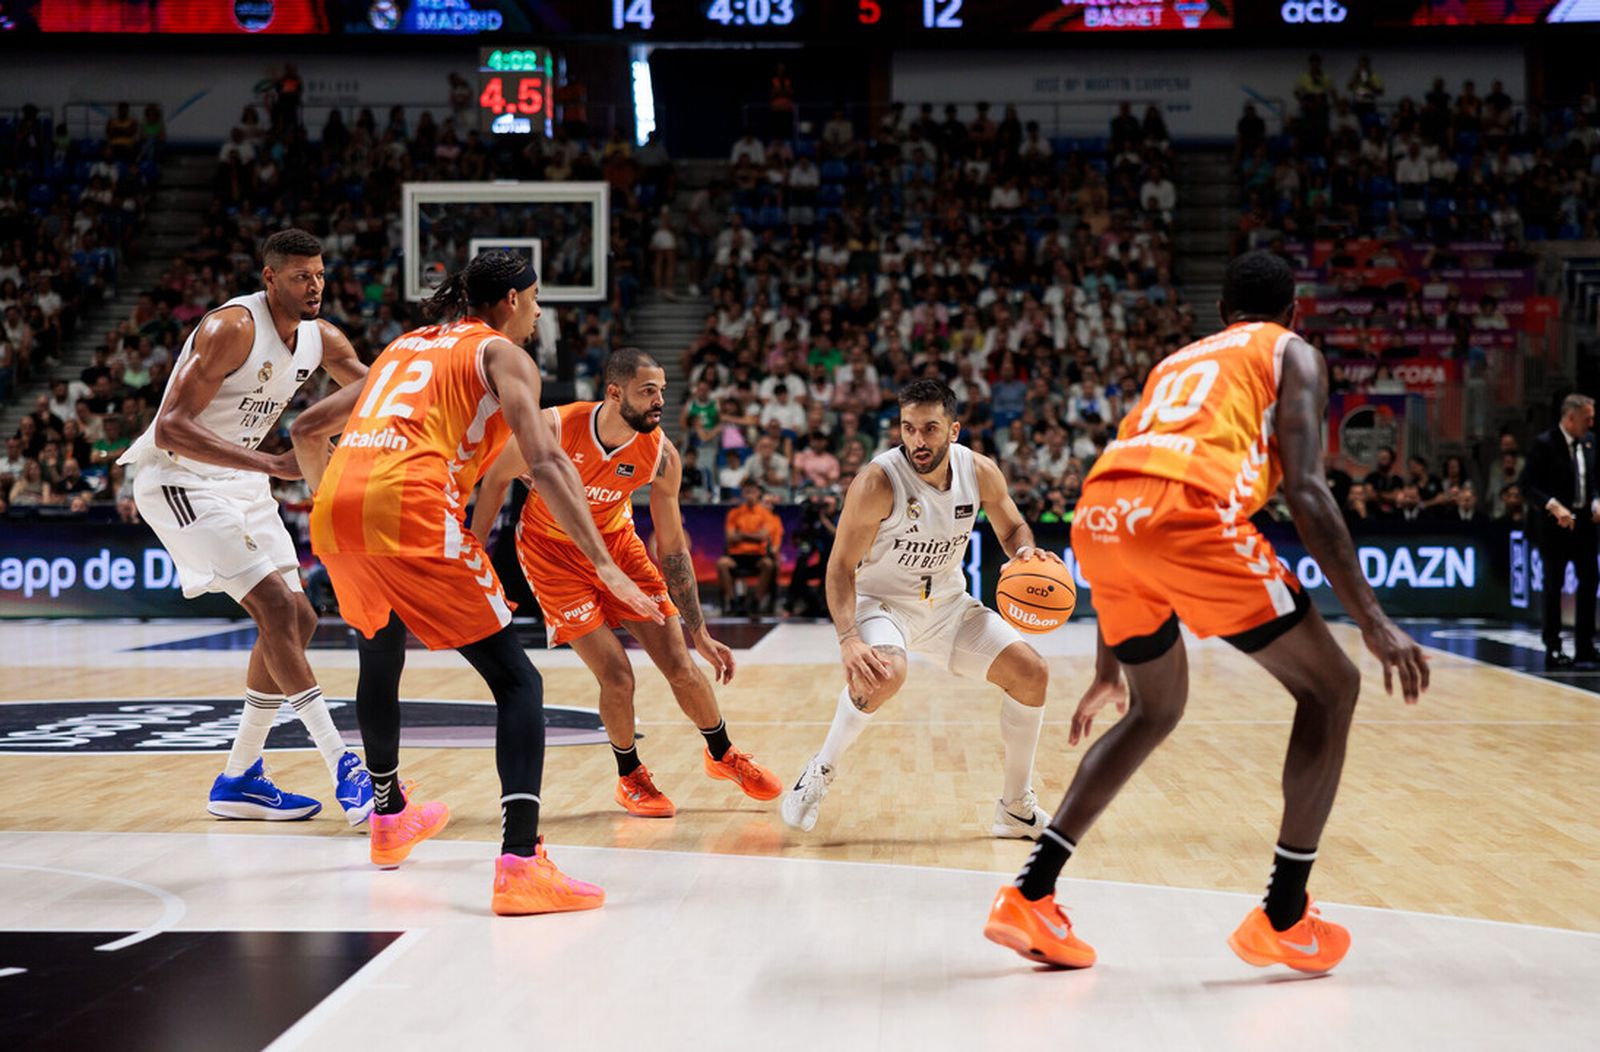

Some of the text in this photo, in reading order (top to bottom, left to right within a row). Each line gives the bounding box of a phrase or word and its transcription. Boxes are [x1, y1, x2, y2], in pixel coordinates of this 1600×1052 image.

[416, 11, 503, 31] MADRID
[612, 0, 655, 29] 14
[707, 0, 794, 25] 4:03
[858, 0, 881, 24] 5
[923, 0, 963, 28] 12
[1084, 7, 1163, 28] BASKET
[1281, 0, 1347, 23] acb
[488, 50, 537, 71] 4:02
[480, 77, 543, 114] 4.5
[358, 360, 433, 419] 12
[1138, 359, 1220, 432] 10
[898, 553, 920, 567] FLY
[1358, 547, 1475, 588] DAZN
[0, 557, 77, 598] app
[83, 549, 136, 590] de
[1026, 584, 1050, 598] acb
[1007, 602, 1059, 627] Wilson
